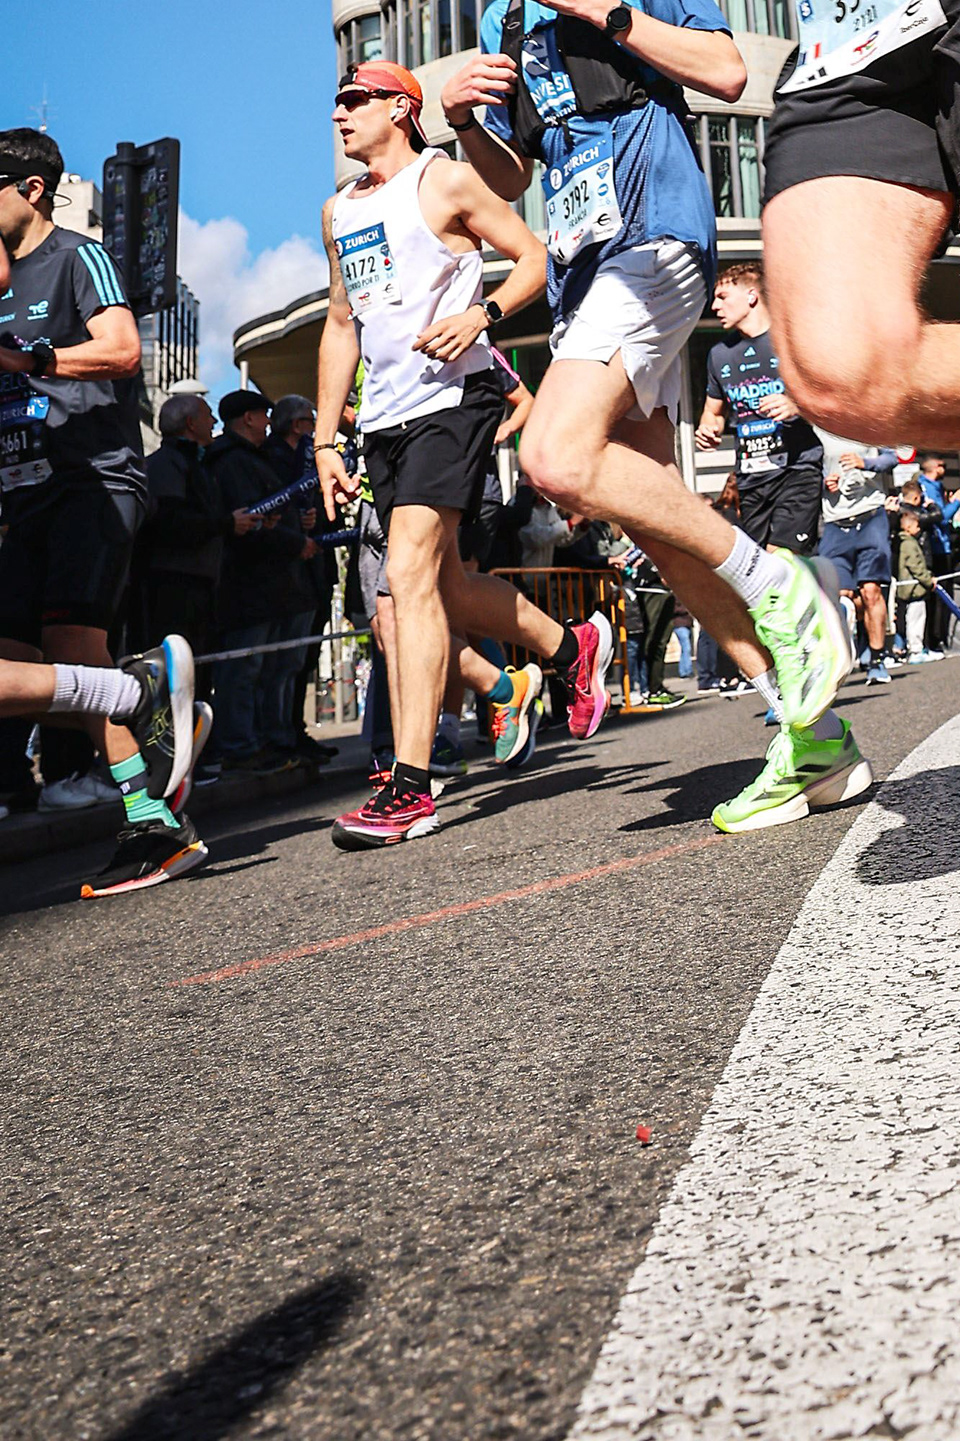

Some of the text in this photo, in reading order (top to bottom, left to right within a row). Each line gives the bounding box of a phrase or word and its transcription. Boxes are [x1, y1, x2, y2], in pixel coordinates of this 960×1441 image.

[563, 146, 600, 177] ZURICH
[562, 179, 590, 221] 3792
[345, 230, 379, 250] ZURICH
[345, 255, 376, 281] 4172
[727, 381, 784, 400] MADRID
